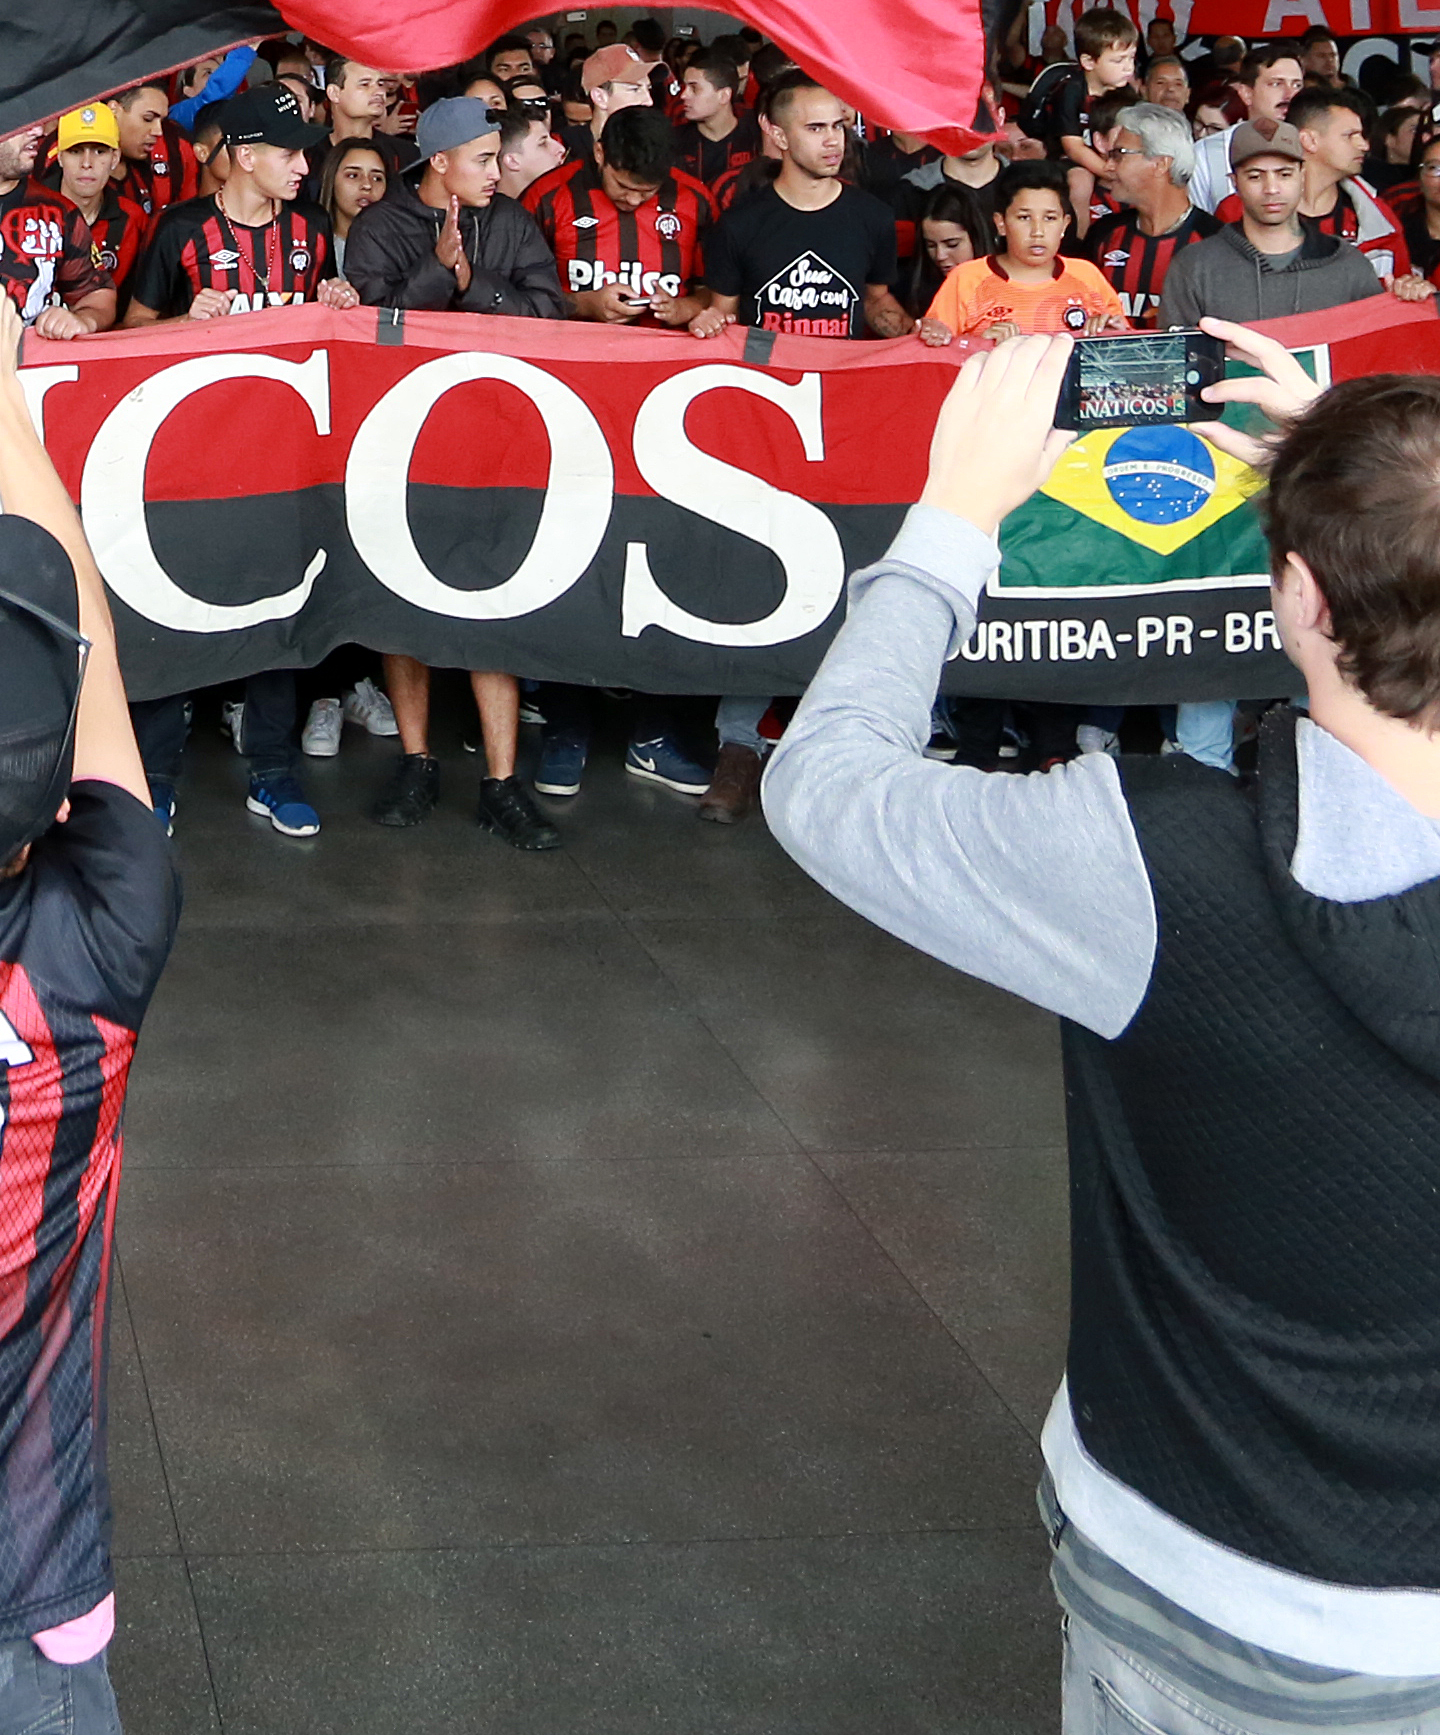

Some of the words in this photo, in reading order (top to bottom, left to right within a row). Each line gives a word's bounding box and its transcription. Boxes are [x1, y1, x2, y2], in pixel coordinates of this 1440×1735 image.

[568, 259, 682, 298] Philco
[789, 259, 833, 288] Sua
[229, 291, 306, 316] AIXA
[768, 285, 819, 311] Casa
[819, 288, 850, 310] com
[762, 311, 849, 338] Rinnai
[1080, 397, 1168, 420] NATICOS
[1156, 464, 1210, 488] PROGRESSO
